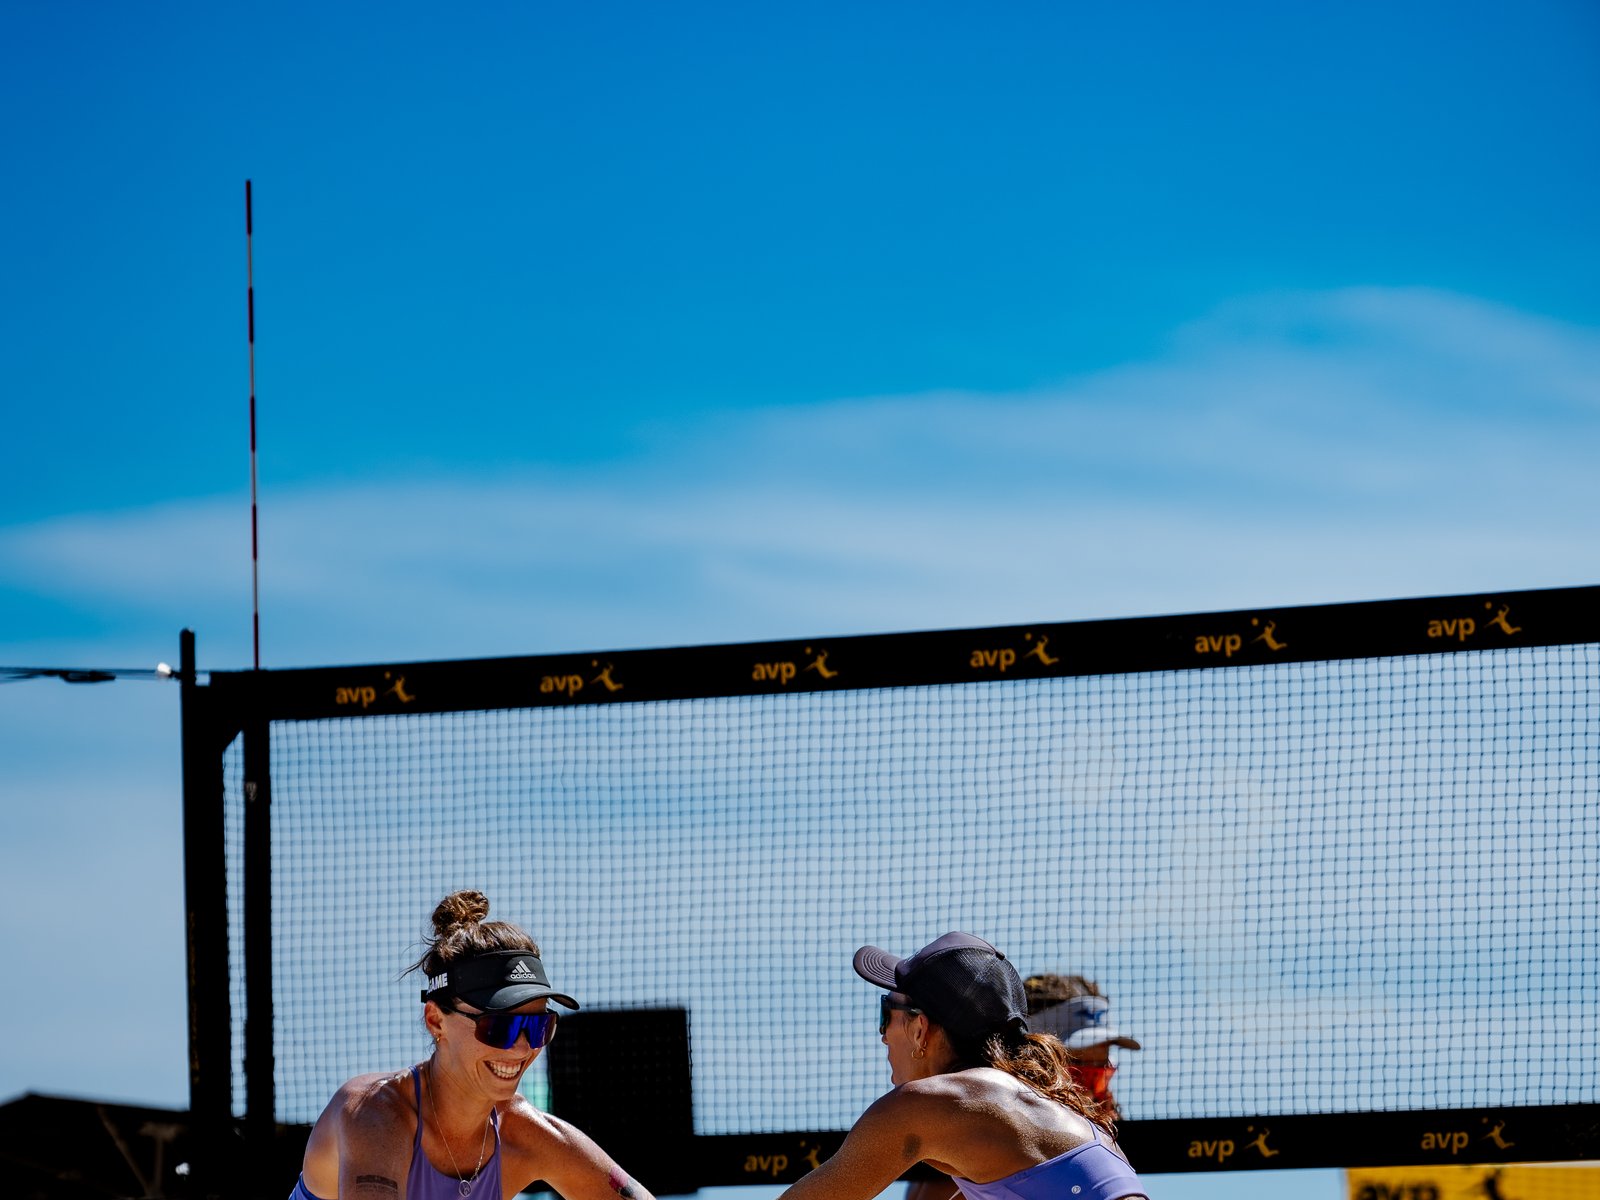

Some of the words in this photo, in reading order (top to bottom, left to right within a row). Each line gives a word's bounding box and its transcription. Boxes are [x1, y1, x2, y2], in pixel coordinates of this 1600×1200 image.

[1426, 617, 1476, 641] avp
[1194, 634, 1242, 657] avp
[969, 648, 1016, 672] avp
[751, 661, 797, 685] avp
[335, 684, 377, 707] avp
[539, 674, 584, 697] avp
[510, 972, 537, 980] adidas
[1187, 1139, 1235, 1163] avp
[1420, 1131, 1469, 1155] avp
[744, 1154, 789, 1178] avp
